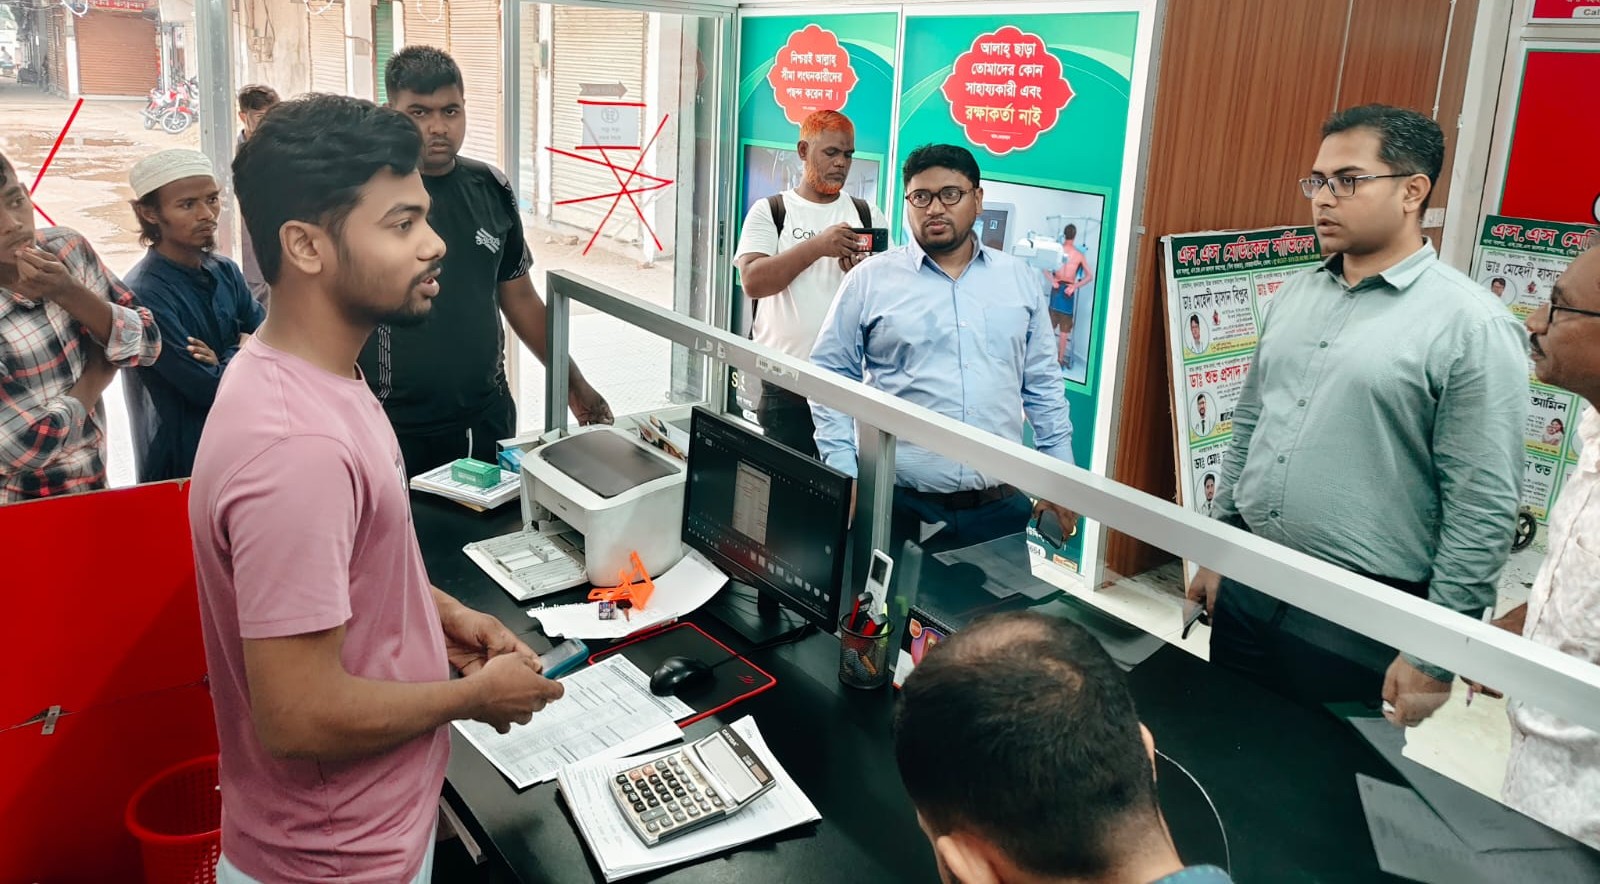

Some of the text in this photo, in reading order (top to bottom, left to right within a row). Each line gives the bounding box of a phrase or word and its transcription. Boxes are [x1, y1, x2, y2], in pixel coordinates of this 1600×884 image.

[1013, 42, 1037, 58] ছাড়া
[971, 62, 1044, 78] তোমাদের কোন
[1020, 85, 1042, 100] এবং
[965, 103, 1042, 128] রক্ষাকর্তা নাই
[1491, 223, 1559, 246] এস.এস
[1223, 235, 1271, 262] মেডিকেল
[1503, 262, 1534, 278] মেহেদী
[1530, 396, 1567, 412] আমিন
